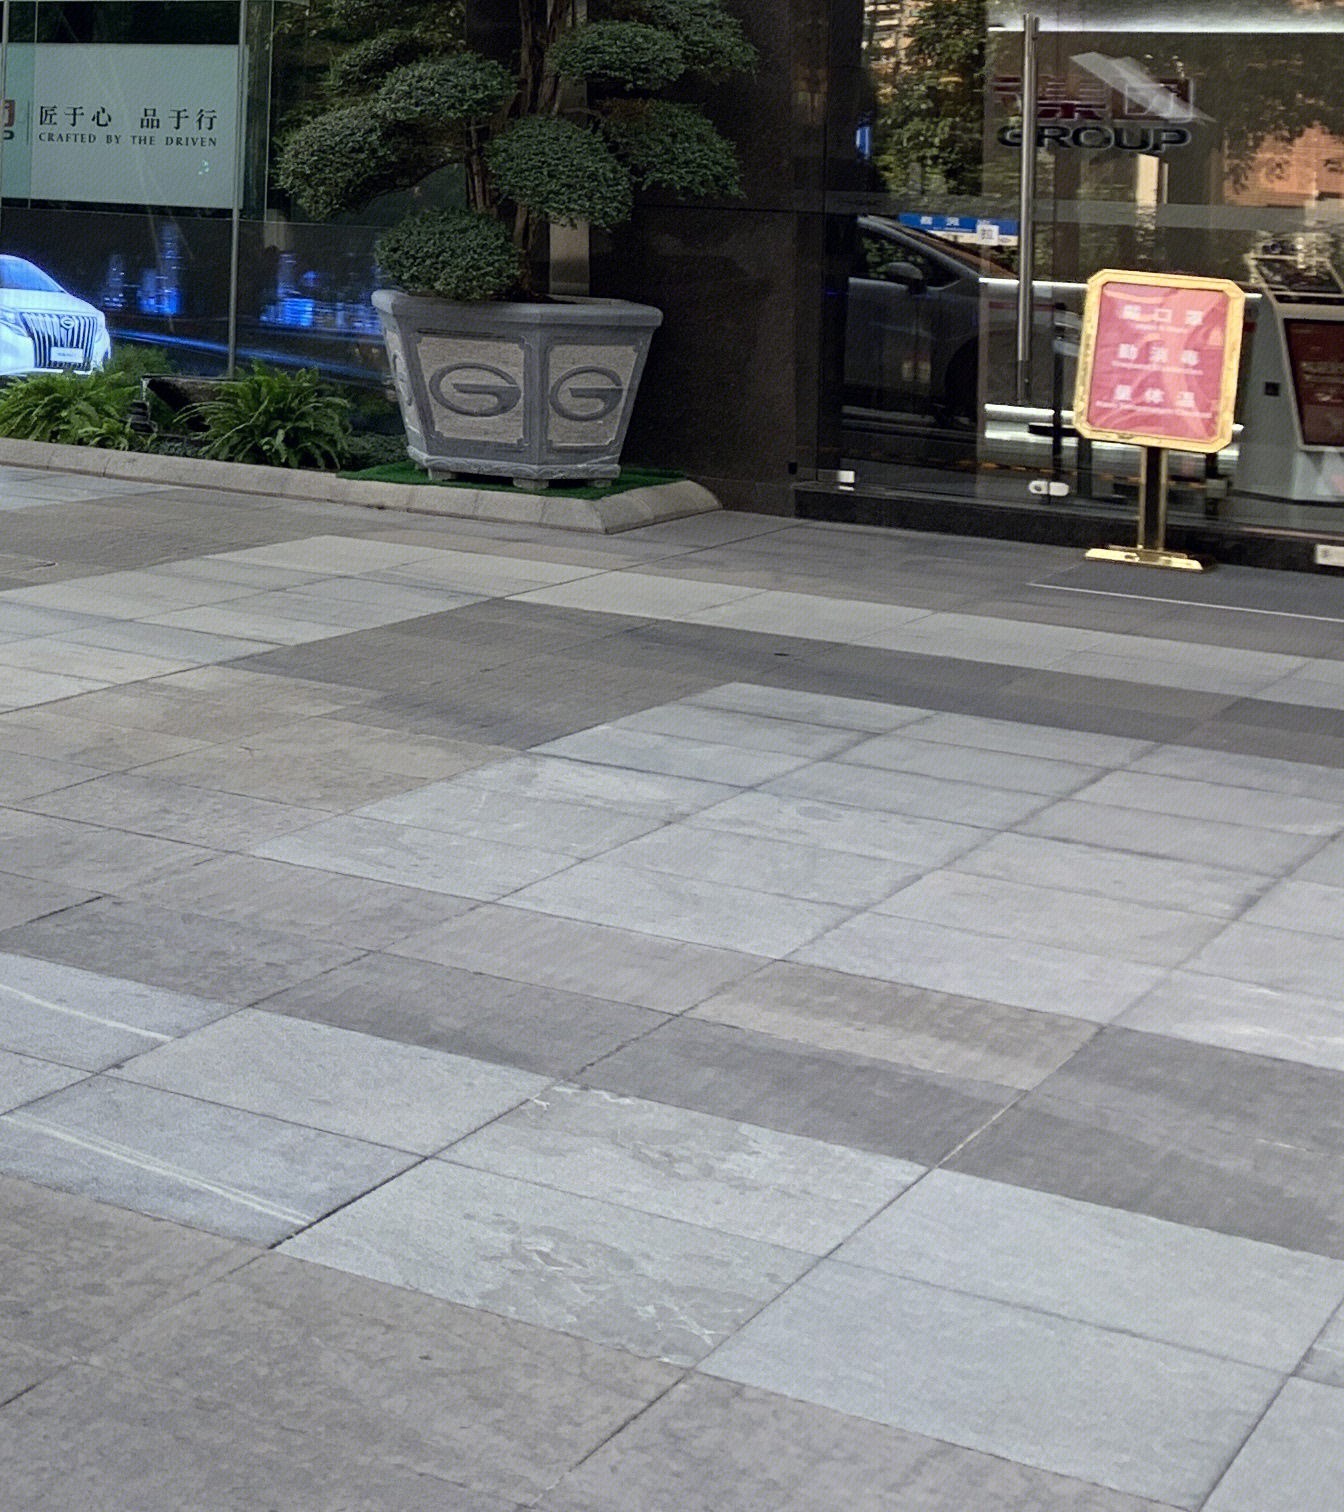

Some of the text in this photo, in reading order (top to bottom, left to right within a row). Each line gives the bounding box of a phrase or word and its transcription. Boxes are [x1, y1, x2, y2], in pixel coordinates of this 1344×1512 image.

[39, 105, 217, 131] 匠于心 品于行
[39, 132, 217, 147] CRAFTED BY THE DRIVEN
